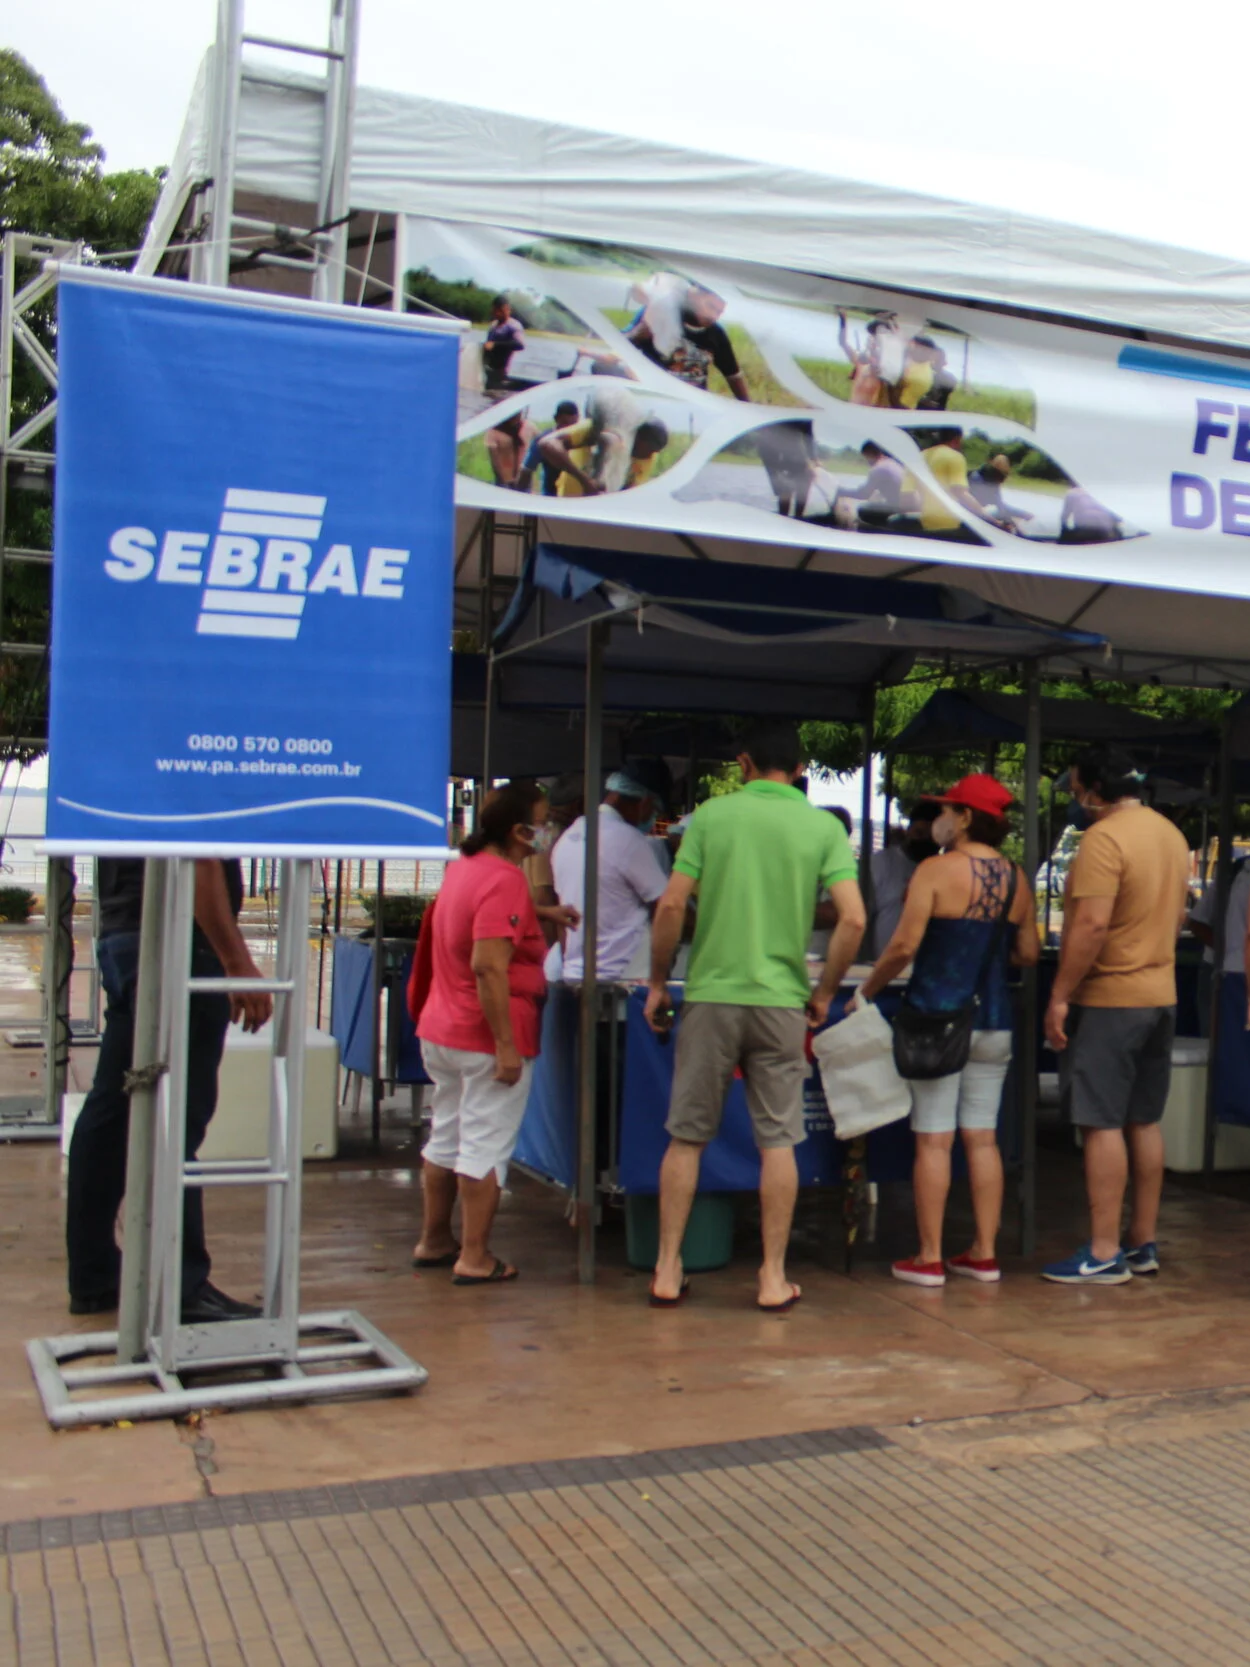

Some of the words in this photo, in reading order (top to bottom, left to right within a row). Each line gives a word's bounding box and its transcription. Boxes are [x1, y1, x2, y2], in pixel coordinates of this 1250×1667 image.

[104, 525, 411, 600] SEBRAE
[187, 734, 238, 752] 0800
[242, 735, 281, 754] 570
[284, 736, 333, 755] 0800
[156, 756, 362, 778] www.pa.sebrae.com.br
